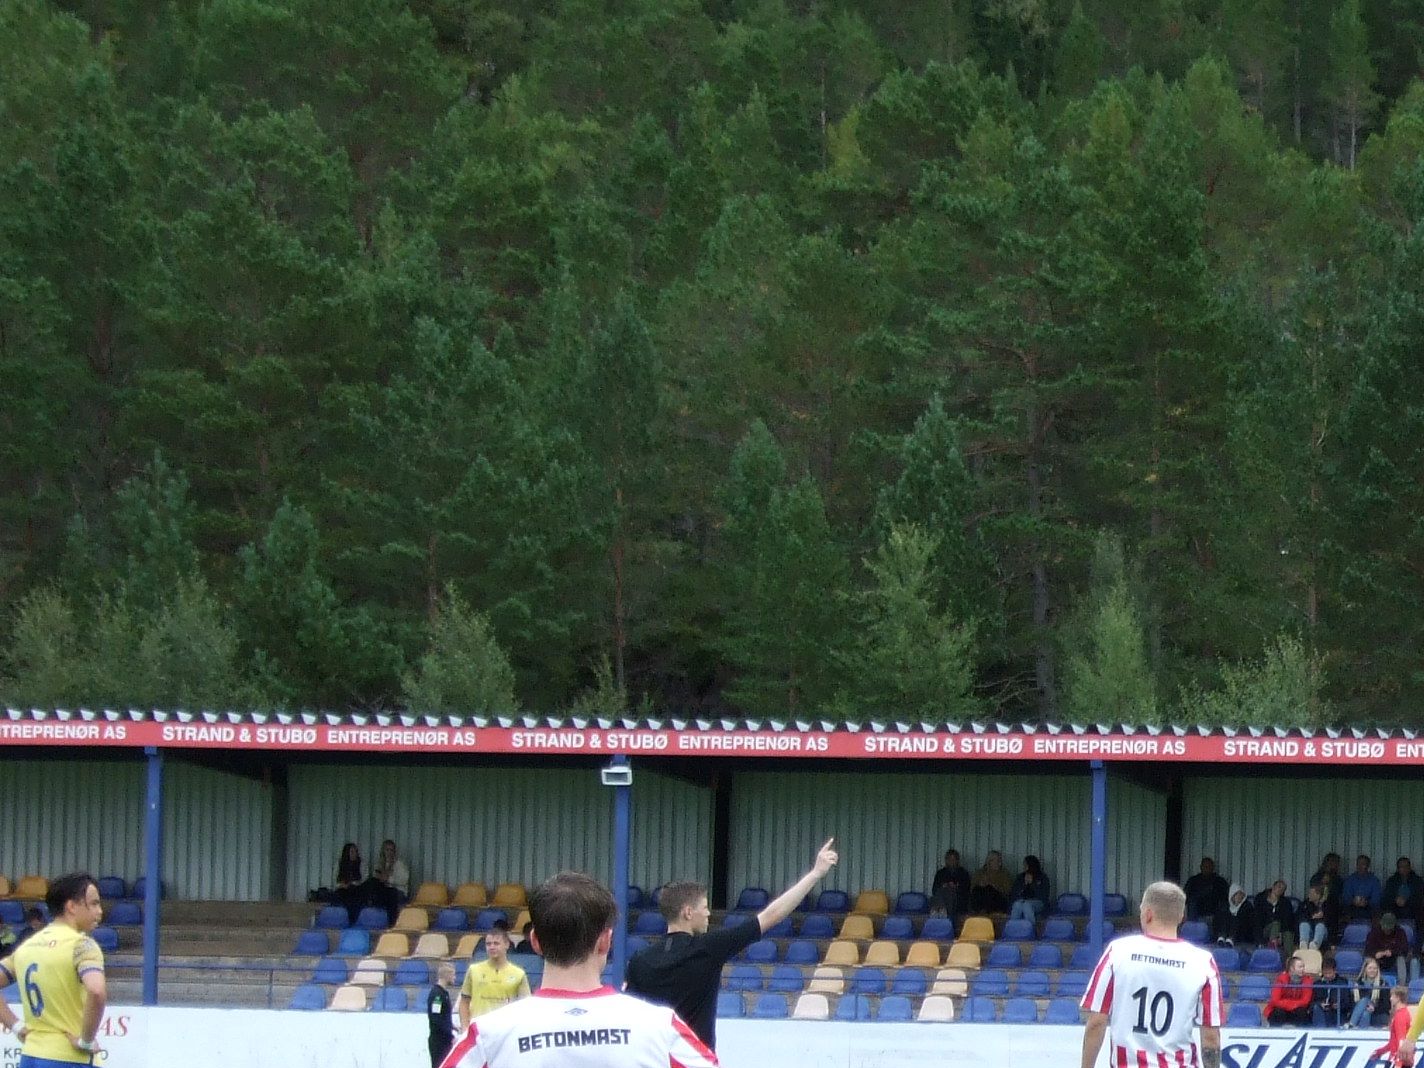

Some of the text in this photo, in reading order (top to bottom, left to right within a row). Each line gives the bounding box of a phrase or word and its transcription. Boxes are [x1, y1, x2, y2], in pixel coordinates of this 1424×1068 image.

[0, 725, 126, 740] TREPRENØR AS
[162, 726, 475, 746] STRAND & STUBØ ENTREPRENØR AS
[512, 732, 828, 751] STRAND & STUBØ ENTREPRENØR AS
[864, 736, 1186, 756] STRAND & STUBØ ENTREPRENØR AS
[1224, 741, 1298, 757] STRAND
[1304, 742, 1316, 757] &
[1321, 742, 1385, 758] STUBØ
[1131, 953, 1186, 969] BETONMAST
[25, 962, 45, 1018] 6
[1132, 986, 1174, 1037] 10
[100, 1016, 131, 1037] AS
[518, 1029, 631, 1053] BETONMAST
